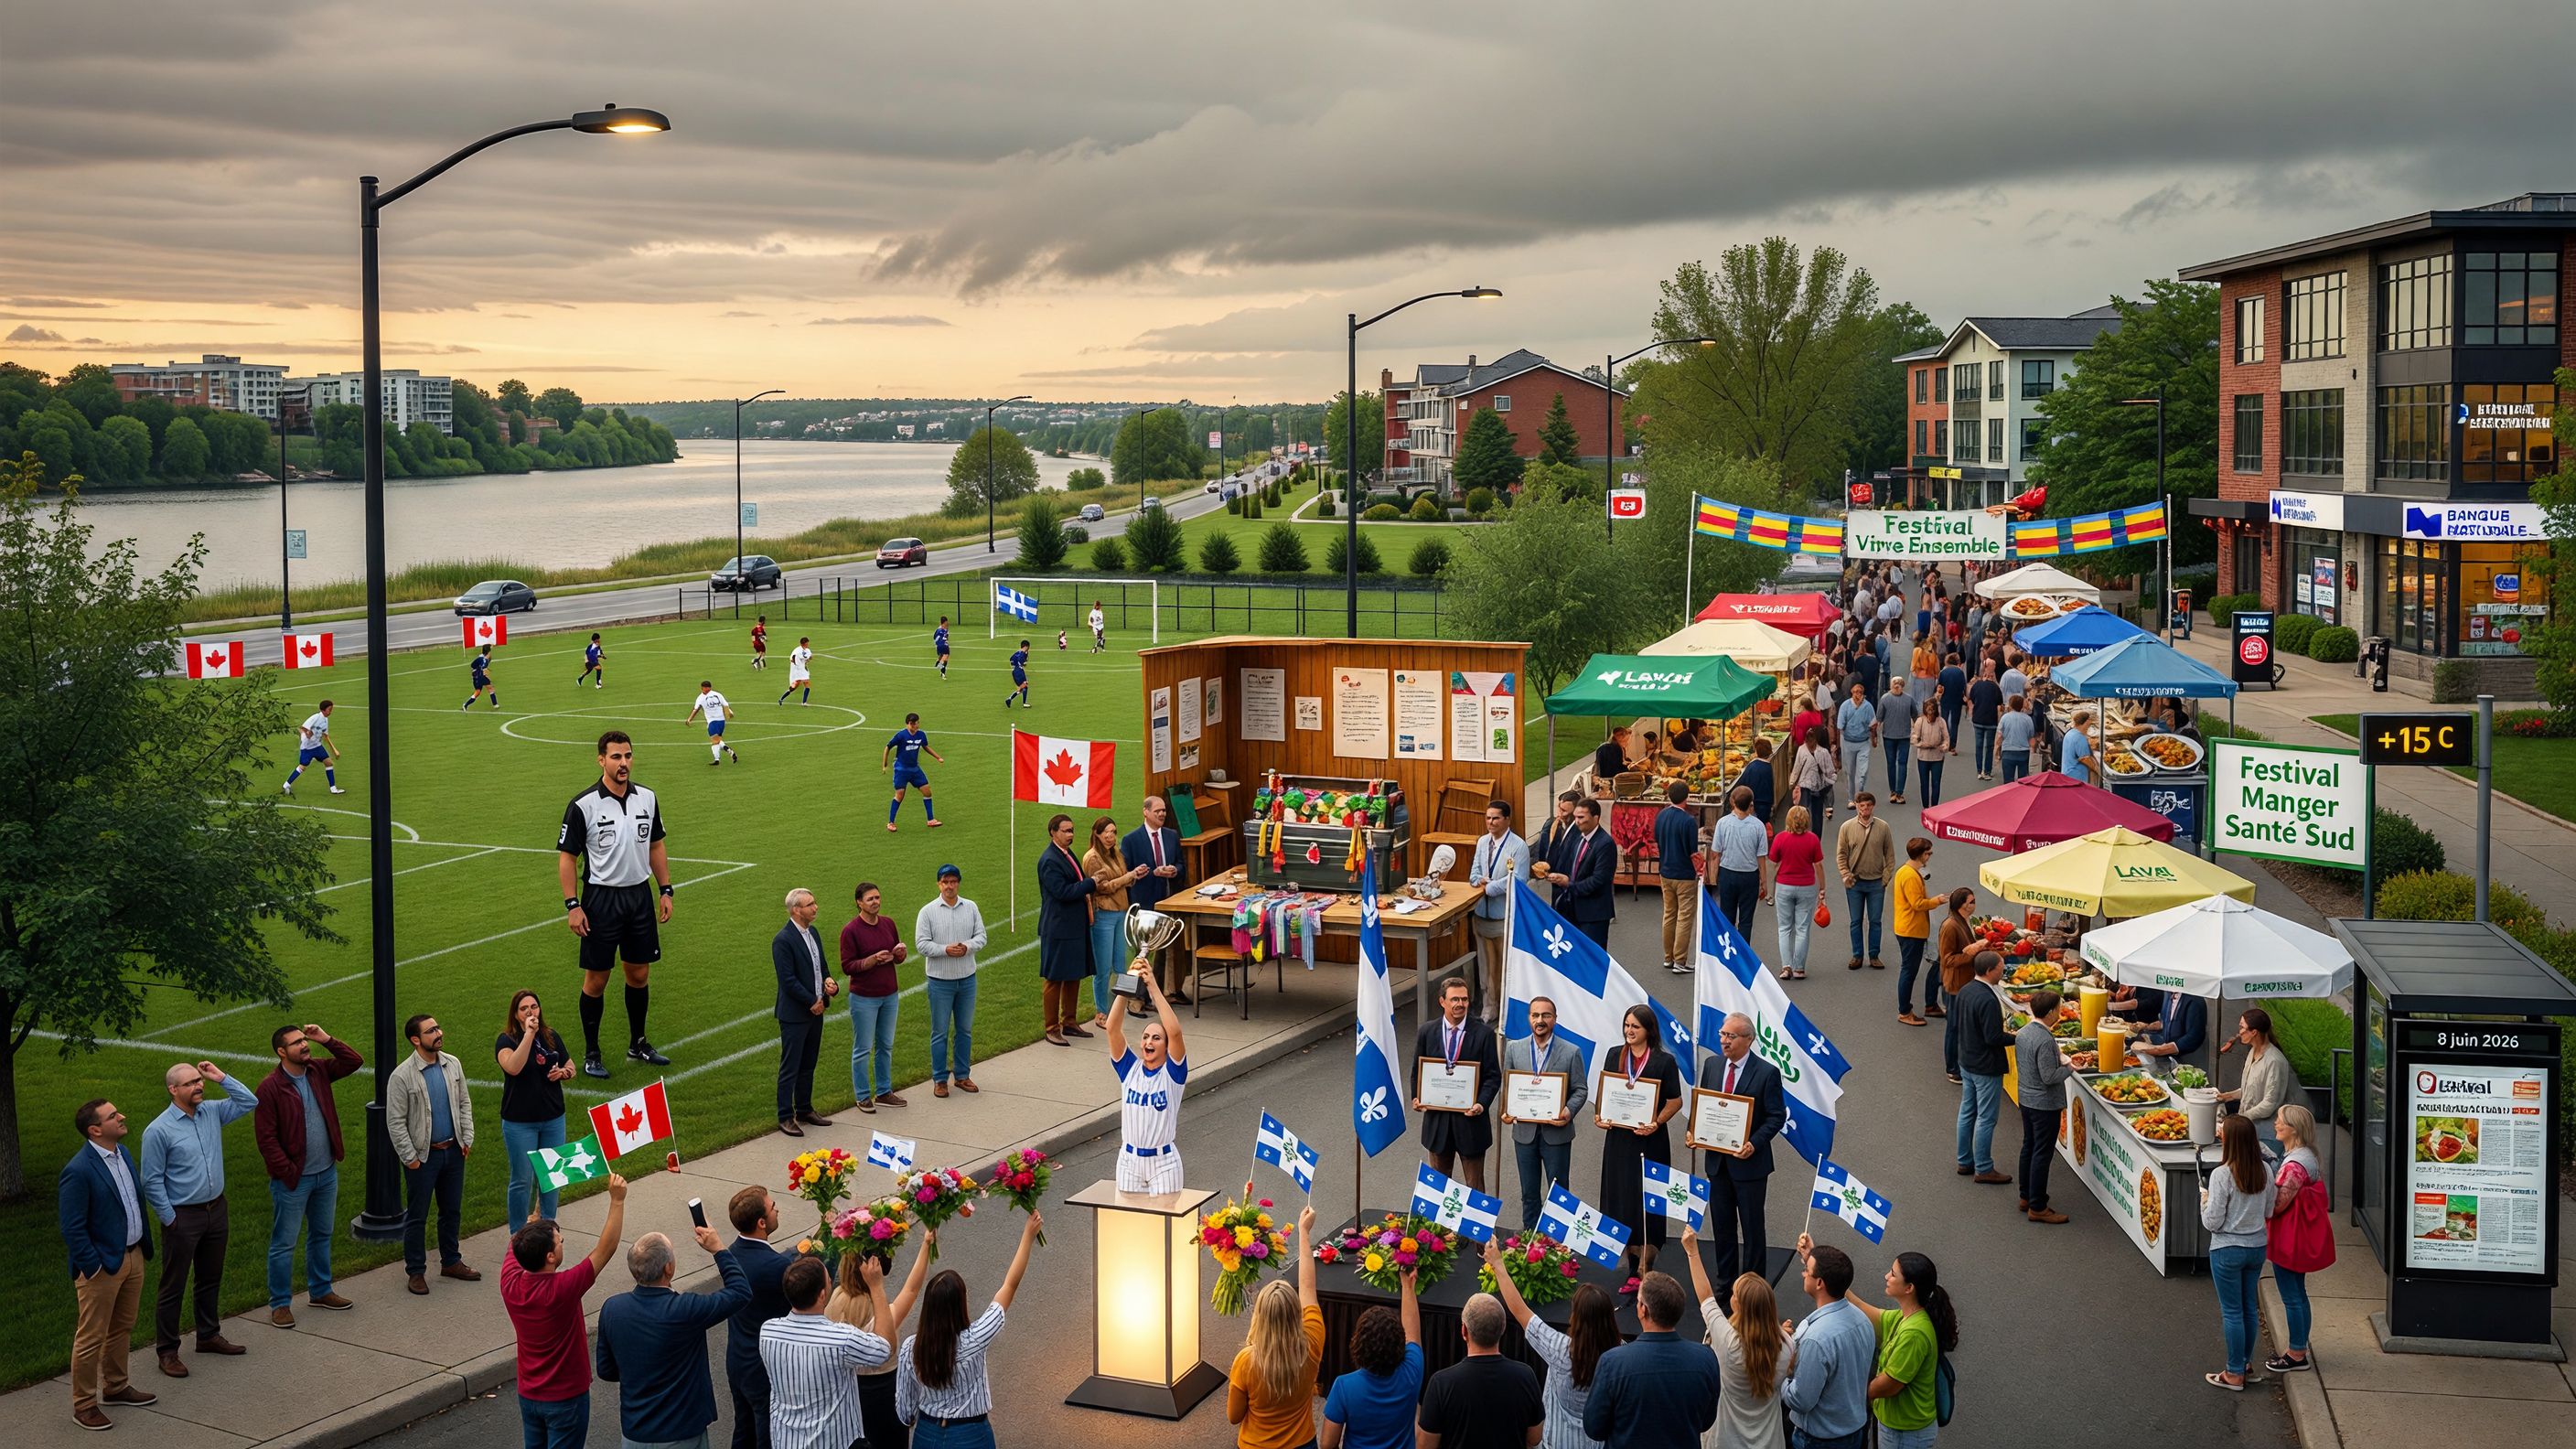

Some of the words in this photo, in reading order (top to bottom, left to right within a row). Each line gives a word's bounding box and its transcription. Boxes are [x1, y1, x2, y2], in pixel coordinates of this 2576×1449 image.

[1908, 536, 2001, 554] Ensemble
[2378, 726, 2431, 753] +15
[2438, 725, 2454, 748] C
[2240, 756, 2340, 788] Festival
[2241, 786, 2339, 821] Manger
[2225, 814, 2297, 844] Santé
[2305, 822, 2355, 851] Sud
[2437, 1032, 2447, 1046] 8
[2450, 1033, 2478, 1048] juin
[2482, 1034, 2519, 1048] 2026
